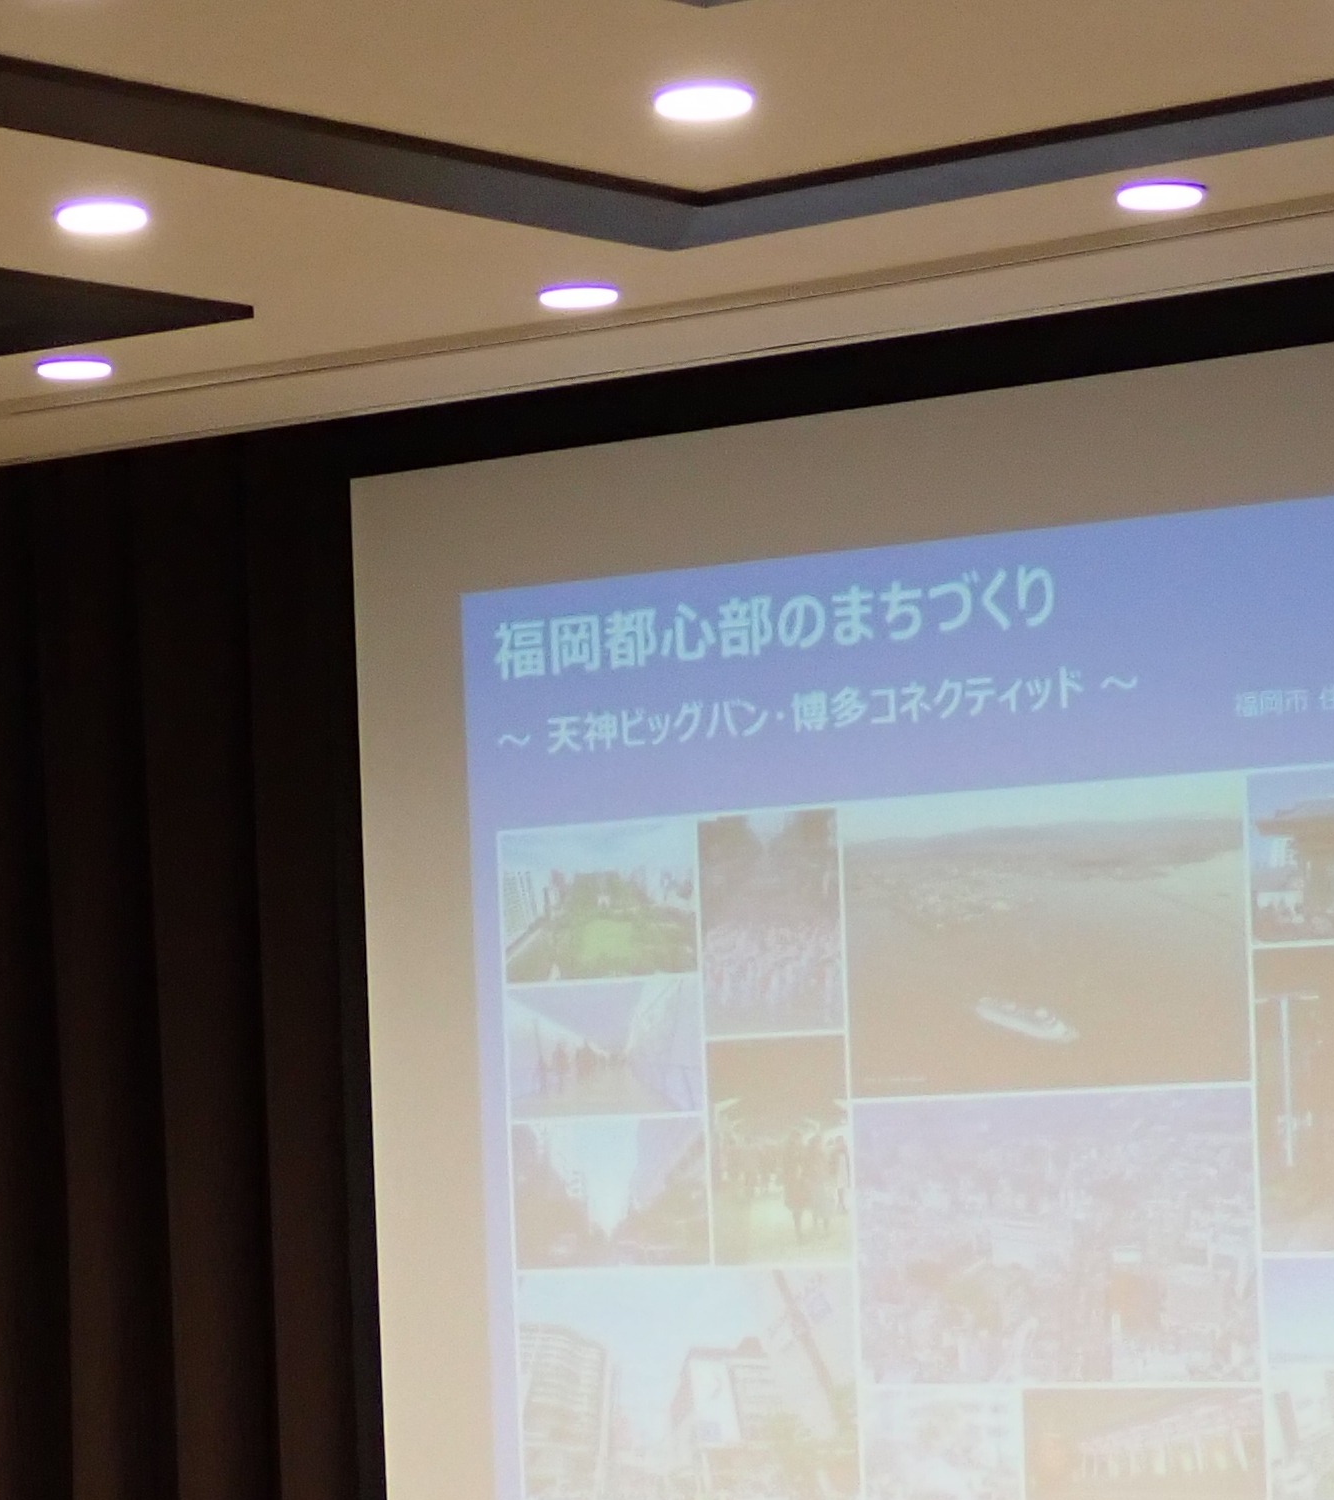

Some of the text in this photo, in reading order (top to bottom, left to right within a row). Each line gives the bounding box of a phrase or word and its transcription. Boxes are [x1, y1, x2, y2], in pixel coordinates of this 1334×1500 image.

[493, 565, 1056, 680] 福岡都心部のまちづくり
[1234, 689, 1309, 717] 福岡市
